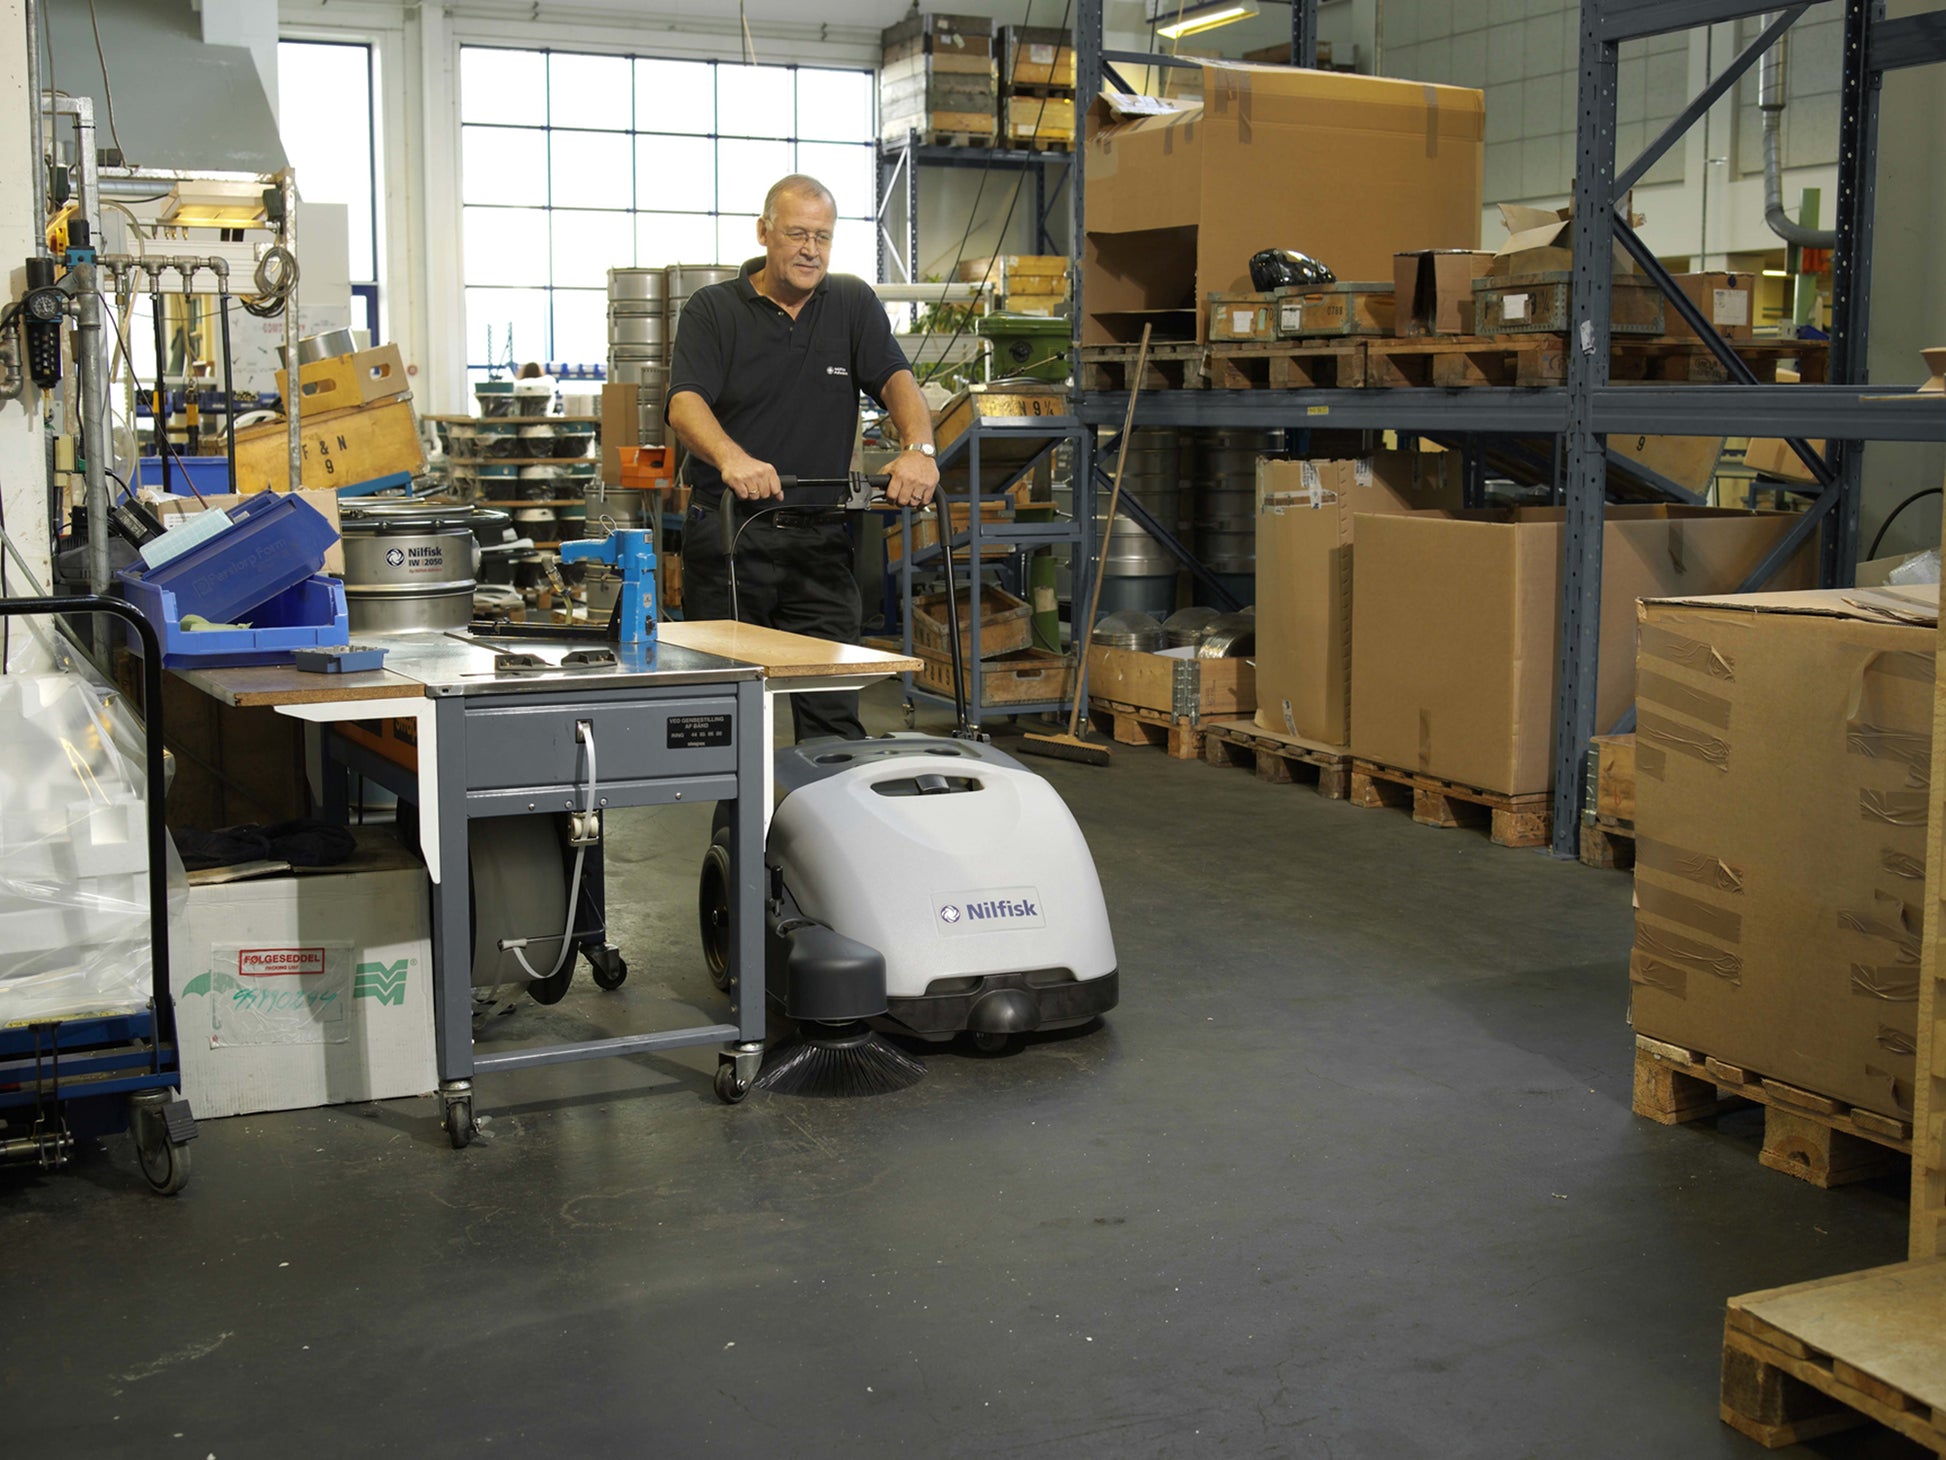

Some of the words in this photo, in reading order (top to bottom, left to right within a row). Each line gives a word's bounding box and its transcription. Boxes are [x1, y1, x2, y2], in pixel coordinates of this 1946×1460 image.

[1032, 400, 1041, 417] 9
[301, 443, 309, 461] F
[319, 439, 330, 456] &
[336, 433, 348, 452] N
[1635, 435, 1647, 452] 9
[324, 458, 335, 475] 9
[408, 546, 442, 557] Nilfisk
[424, 558, 443, 567] 2050
[966, 899, 1038, 920] Nilfisk
[243, 953, 321, 966] FØLGESEDDEL
